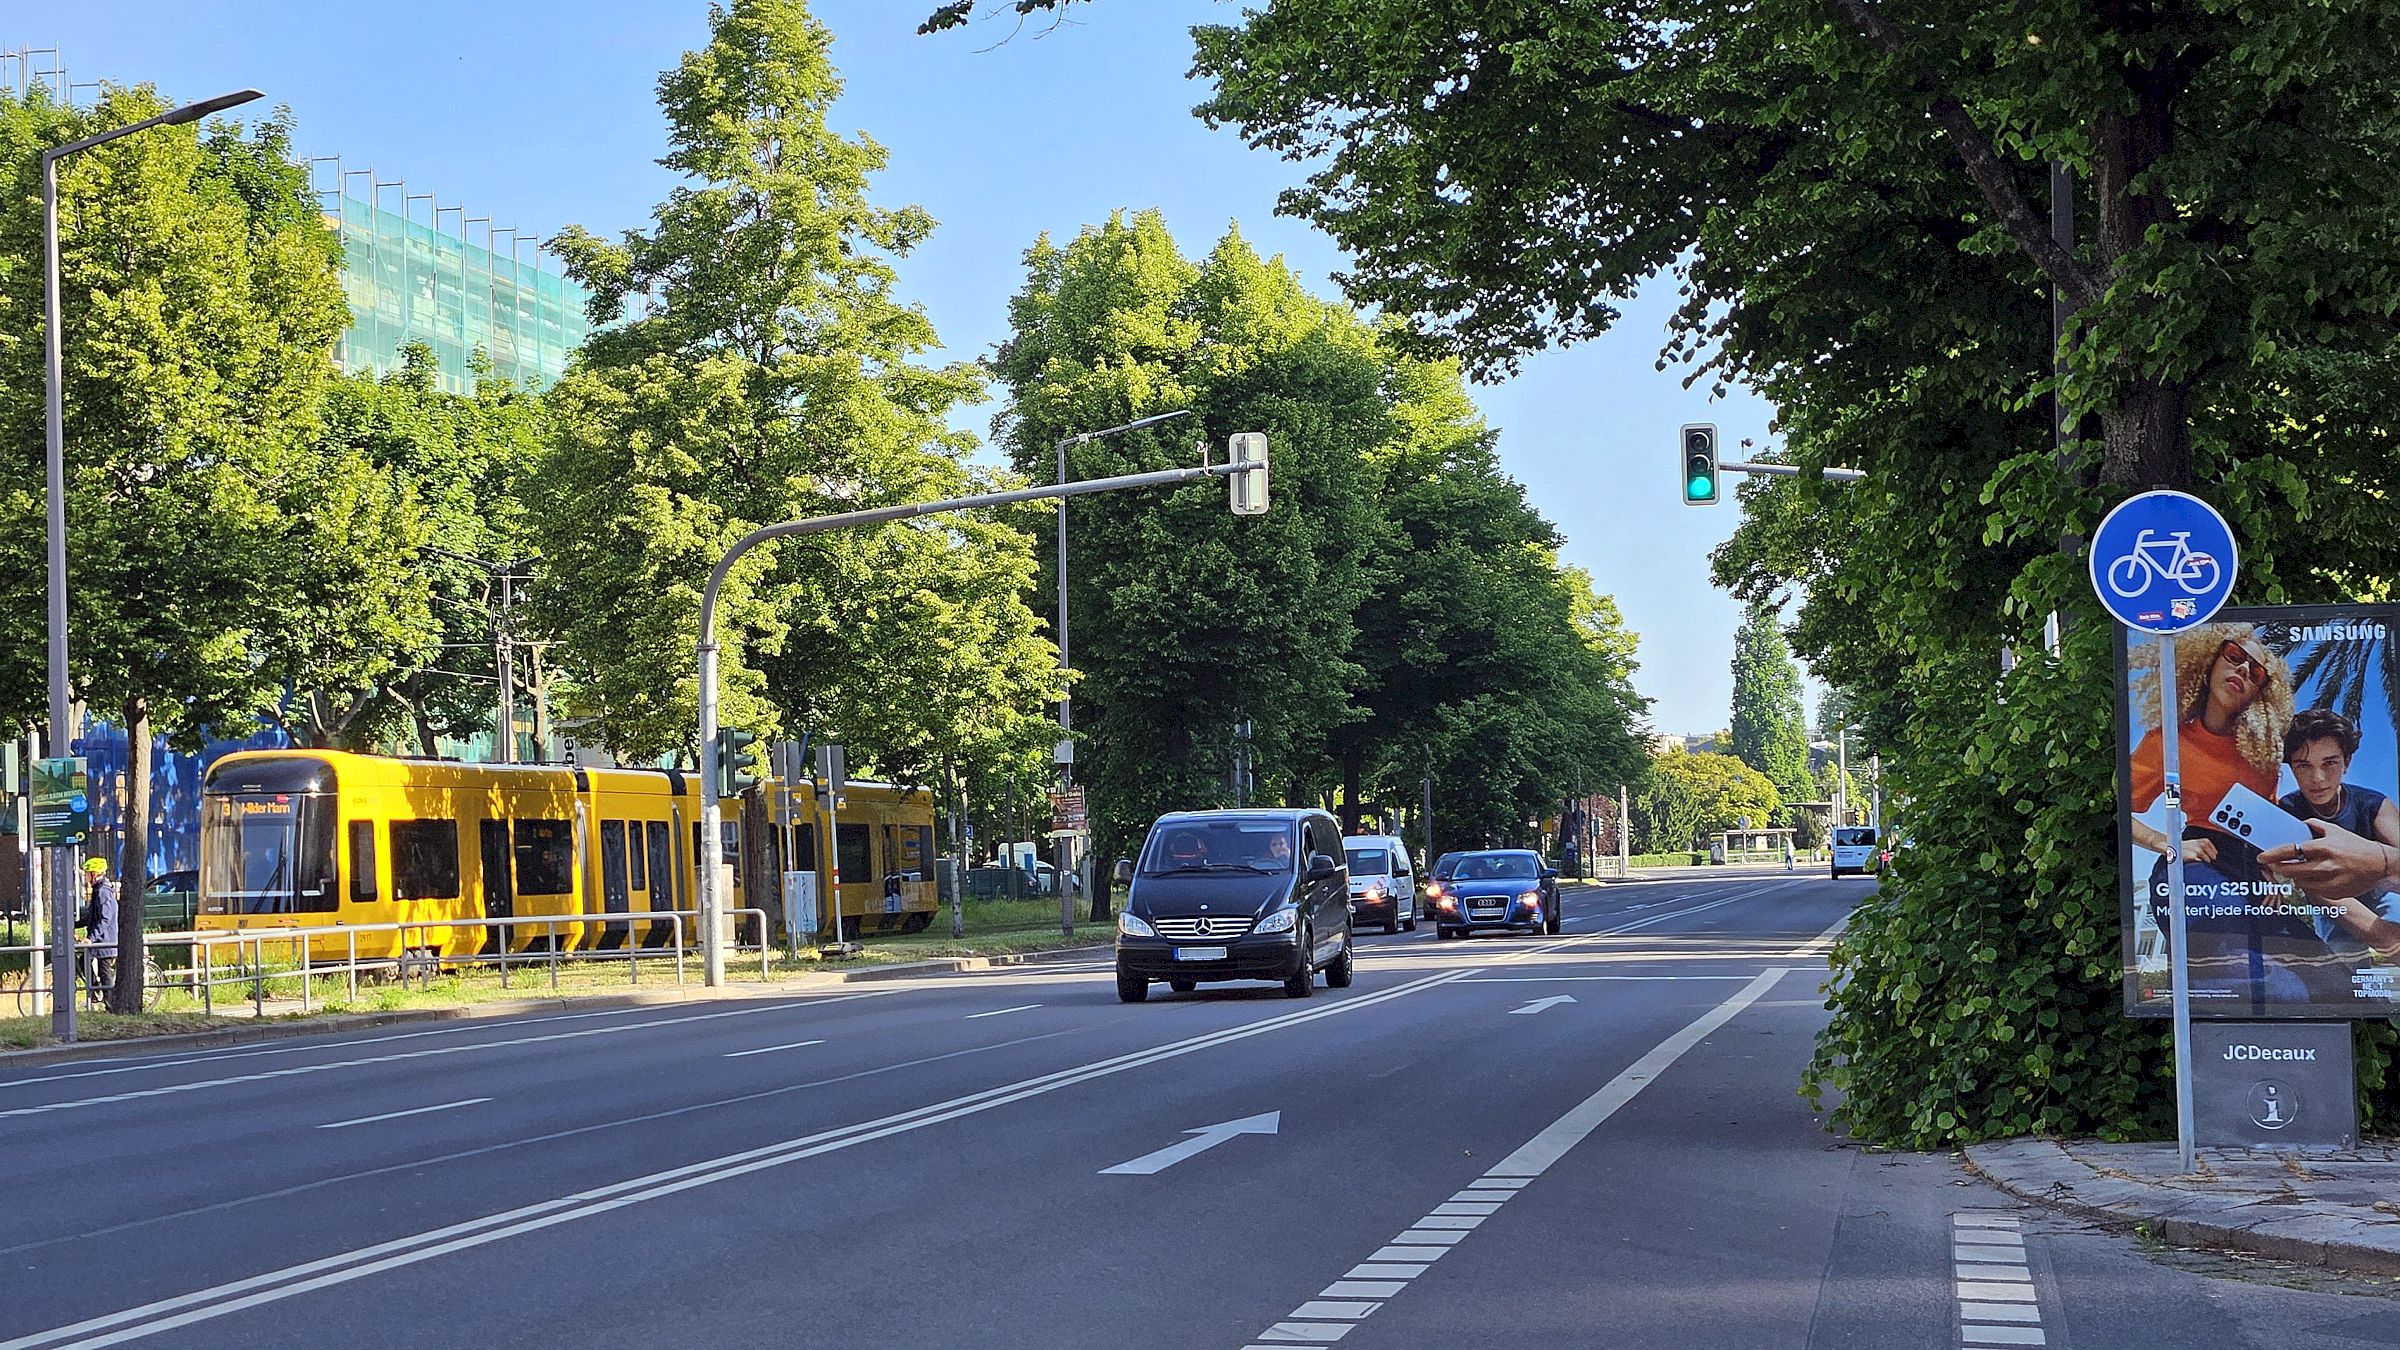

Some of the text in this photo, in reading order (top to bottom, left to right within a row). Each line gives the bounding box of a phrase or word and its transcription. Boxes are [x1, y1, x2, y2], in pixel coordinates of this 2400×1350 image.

[2289, 624, 2386, 642] SAMSUNG
[241, 802, 266, 814] Wilder
[267, 802, 290, 814] Mann
[2220, 881, 2250, 896] S25
[2252, 881, 2292, 896] Ultra
[2210, 904, 2242, 919] jede
[2244, 904, 2348, 918] Foto-Challenge
[2351, 975, 2394, 984] GERMANY'S
[2352, 989, 2392, 998] TOPMODEL
[2223, 1045, 2316, 1060] JCDecaux
